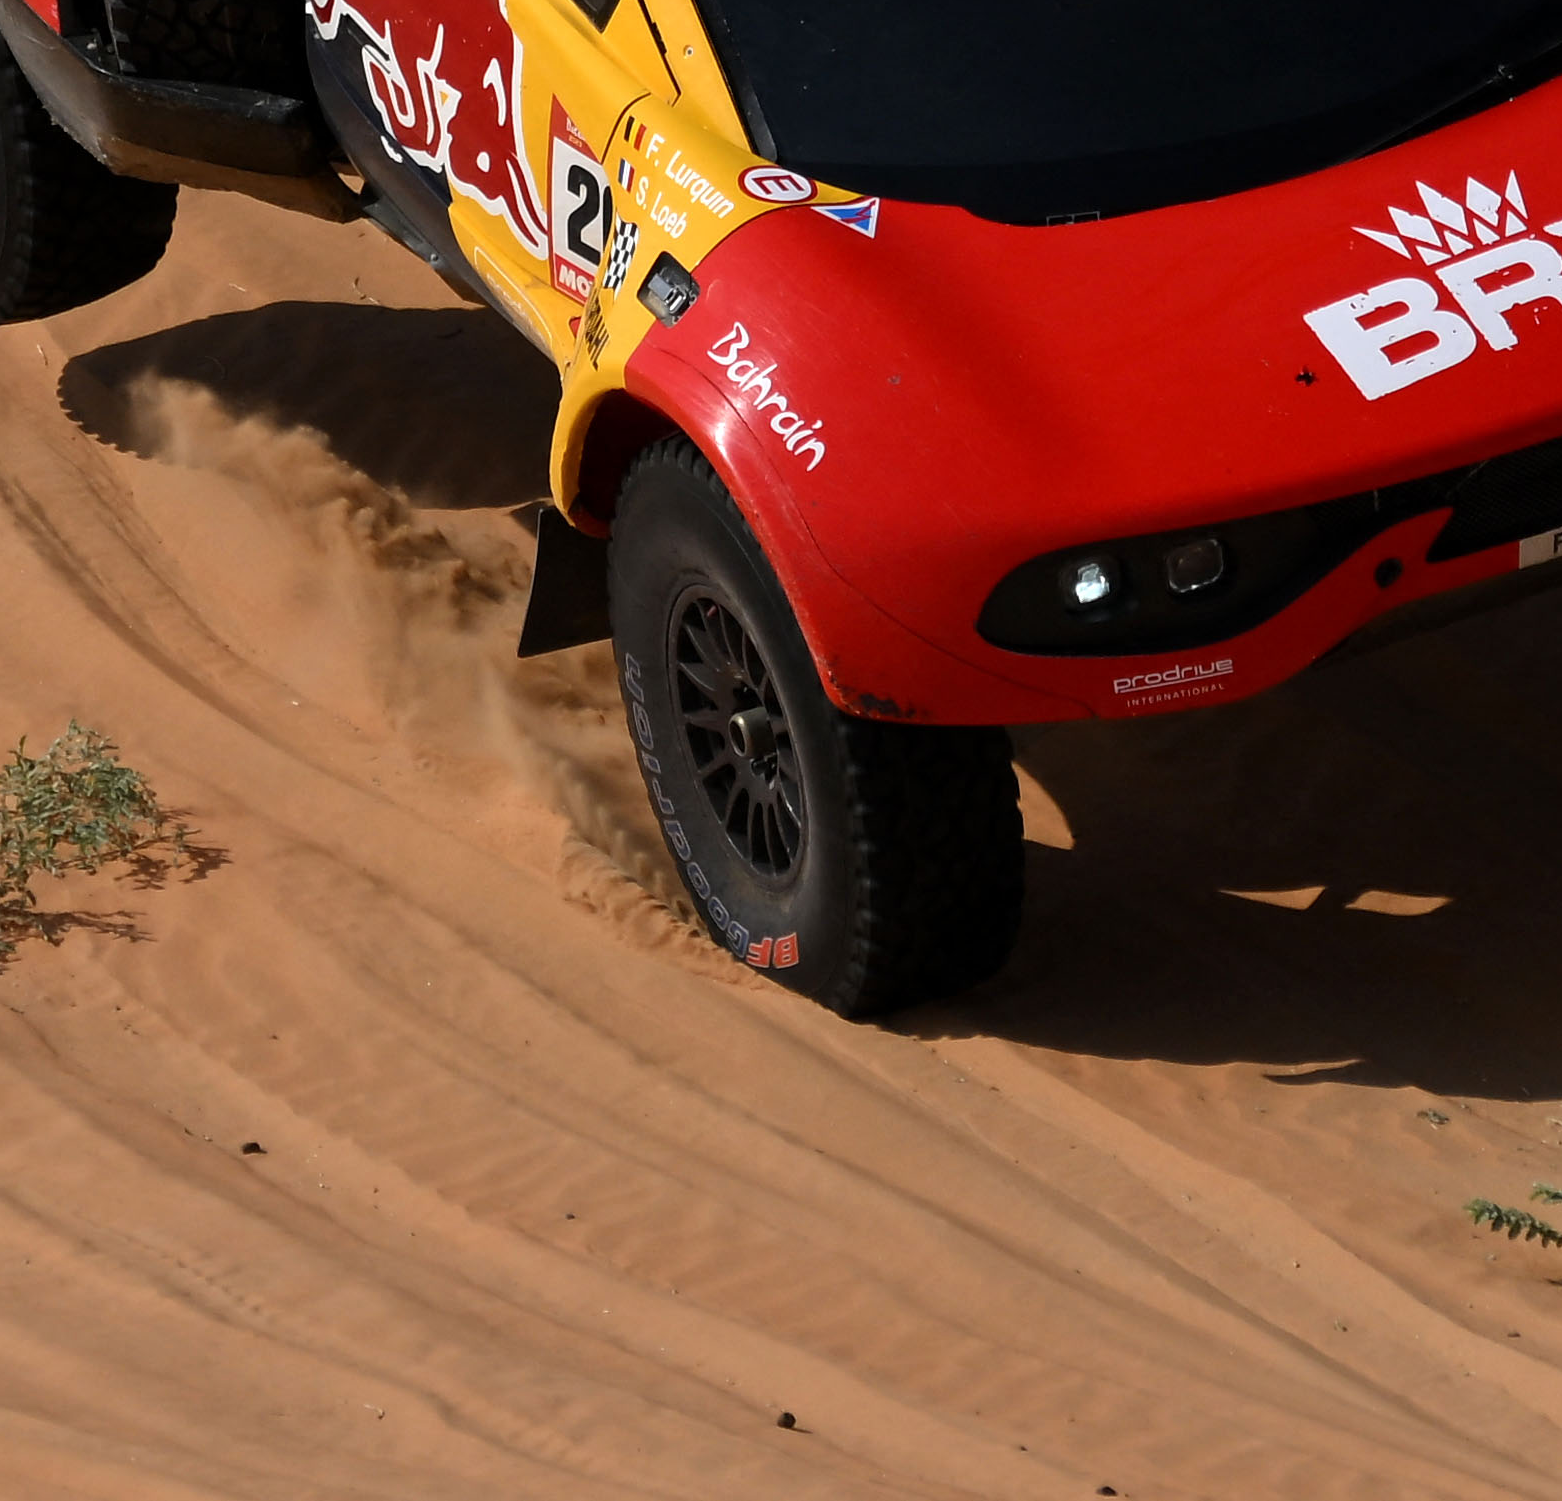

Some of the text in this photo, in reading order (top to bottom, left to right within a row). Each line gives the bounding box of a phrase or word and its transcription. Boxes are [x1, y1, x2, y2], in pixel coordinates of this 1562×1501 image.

[636, 176, 687, 238] S. Loeb
[645, 133, 735, 219] F. Lurquin
[707, 322, 826, 472] Bahrain
[1113, 659, 1233, 693] prodrive
[1127, 683, 1225, 708] INTERNATIONAL
